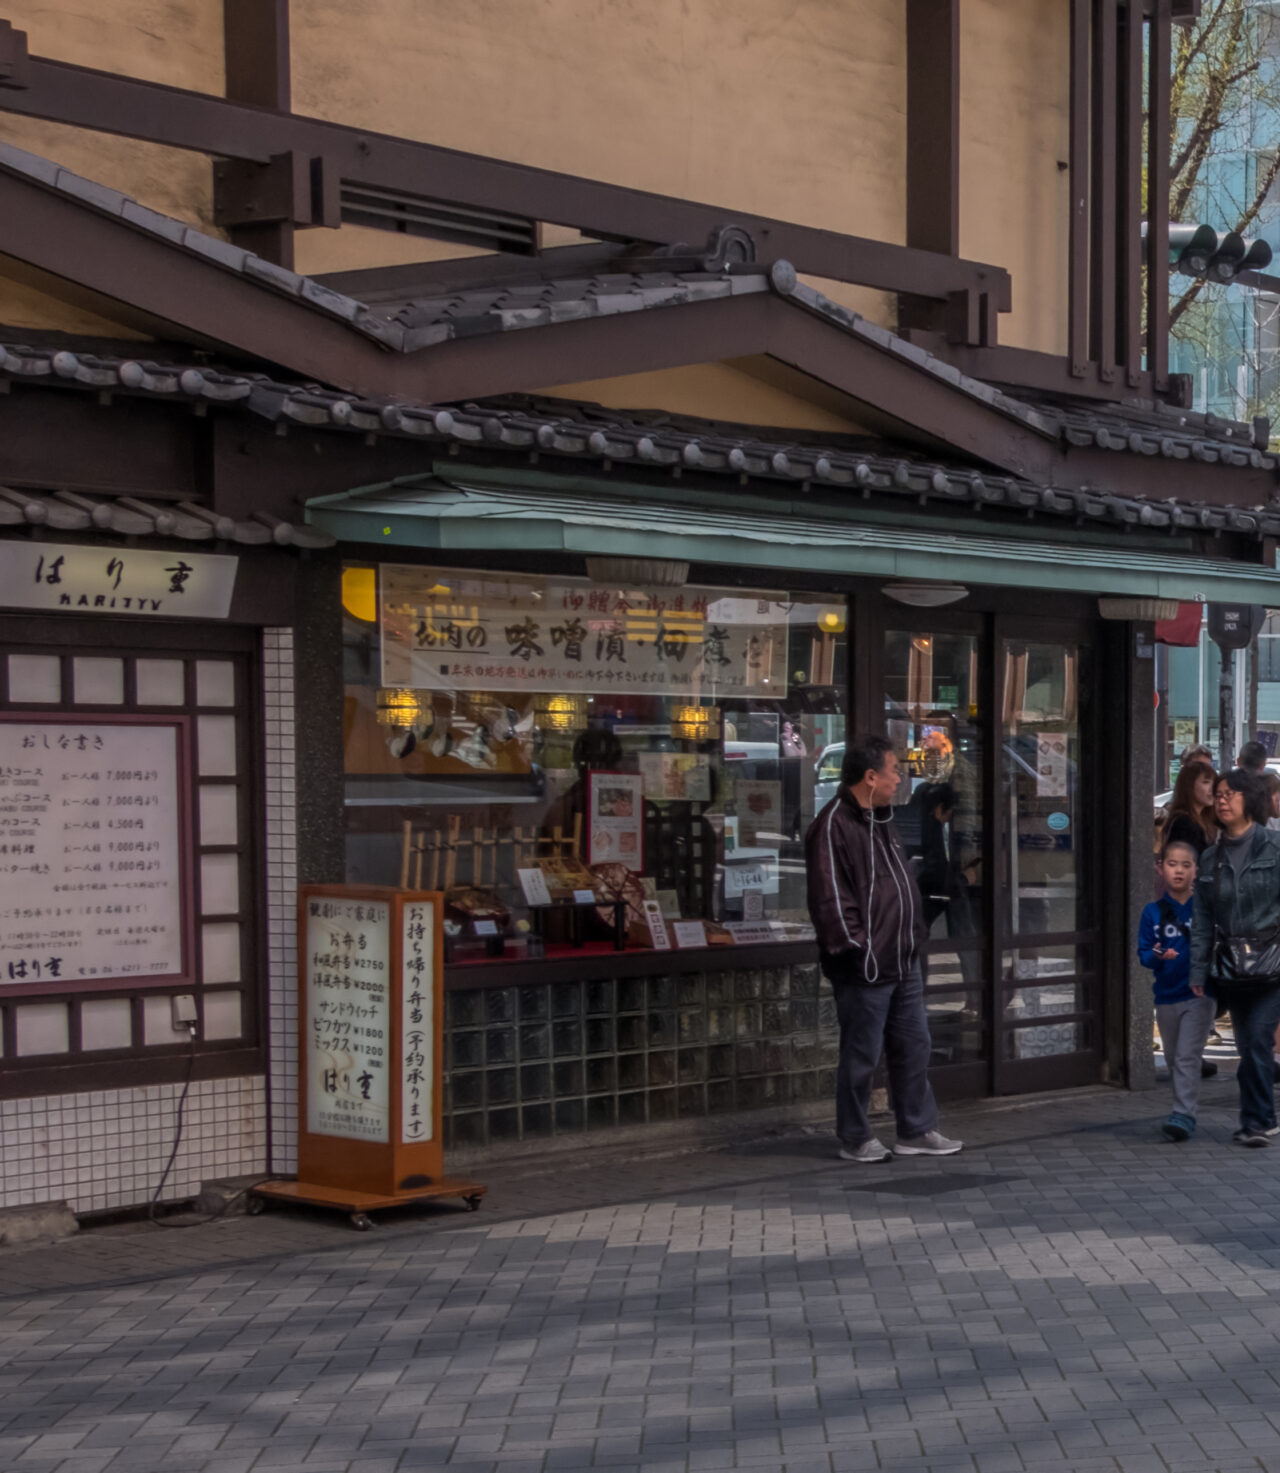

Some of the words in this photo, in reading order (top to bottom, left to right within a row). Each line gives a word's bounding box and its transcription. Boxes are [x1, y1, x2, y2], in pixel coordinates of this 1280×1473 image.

[330, 932, 367, 951] お弁当
[8, 957, 63, 980] はり重
[323, 1069, 374, 1100] はり重
